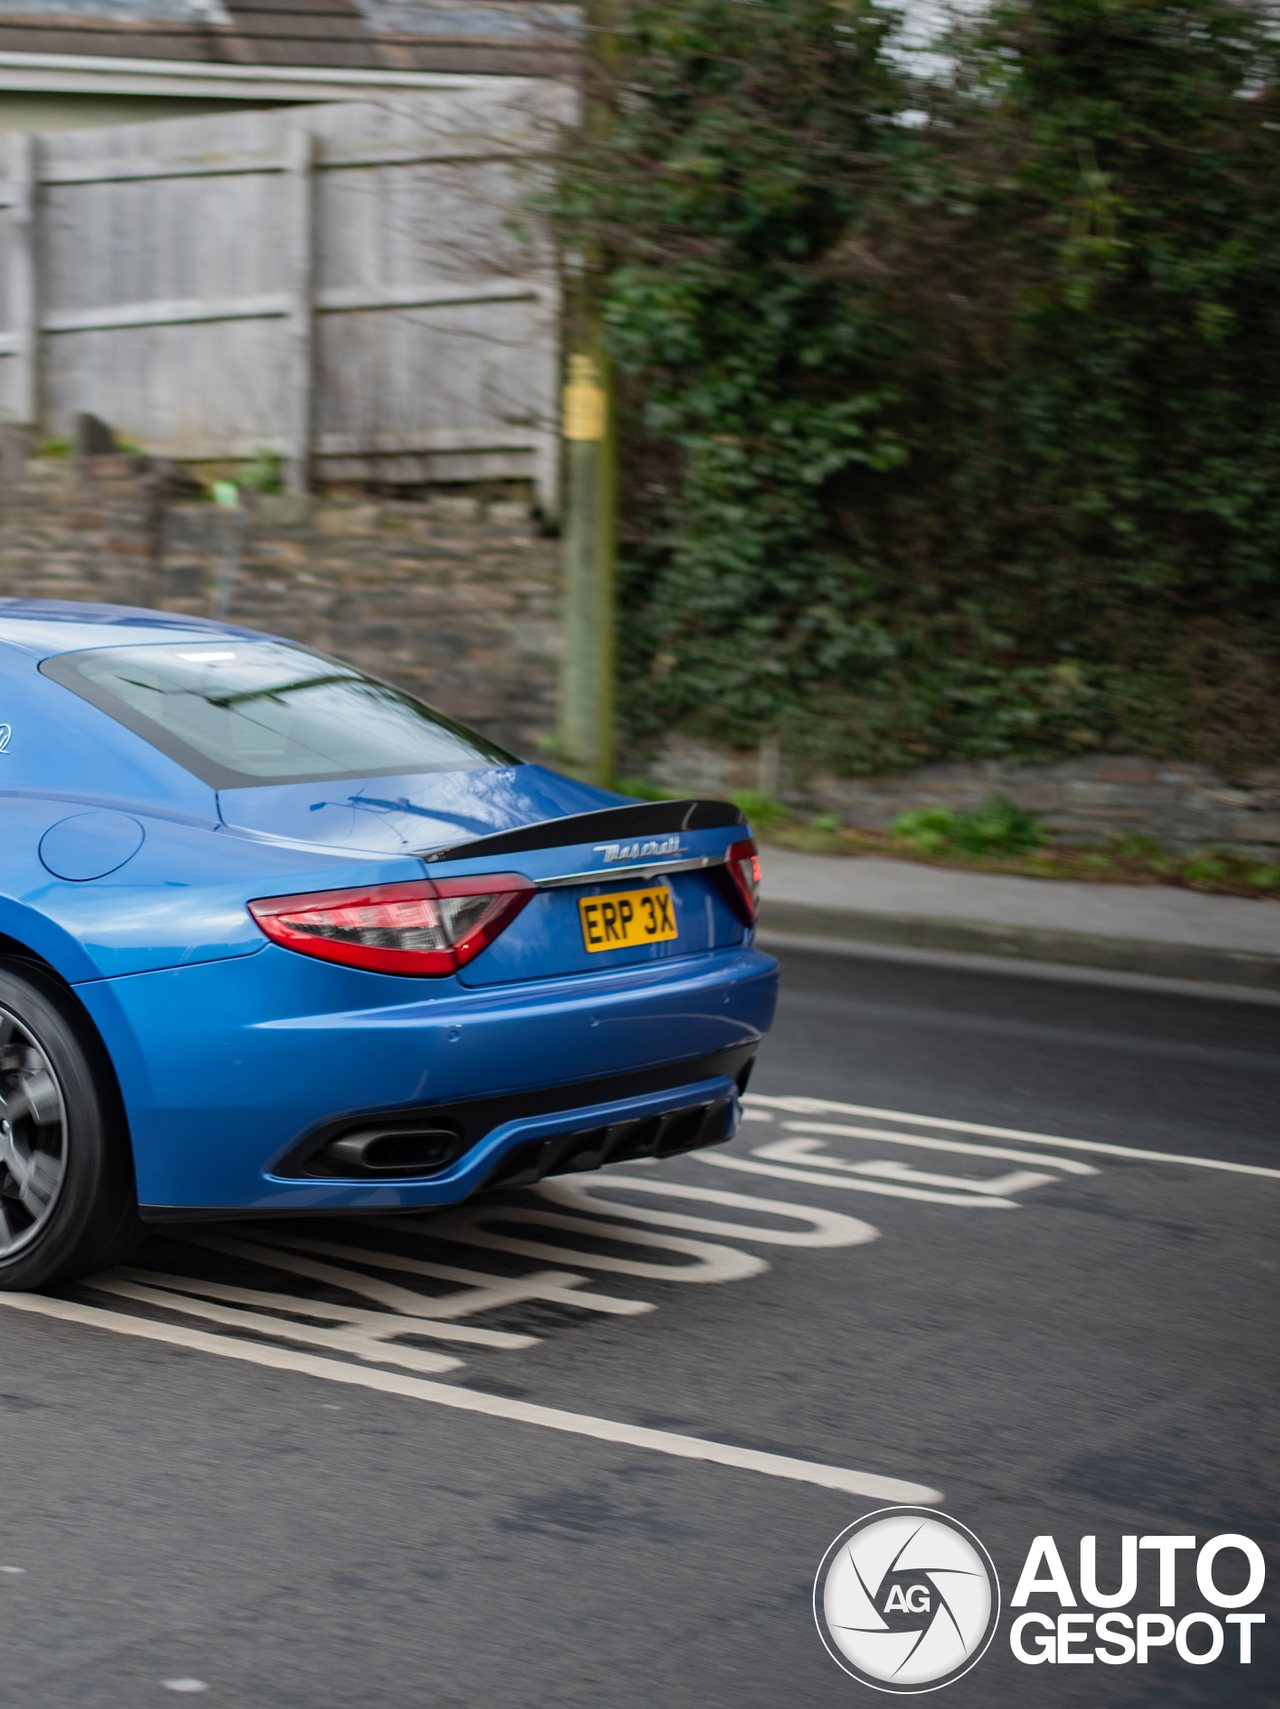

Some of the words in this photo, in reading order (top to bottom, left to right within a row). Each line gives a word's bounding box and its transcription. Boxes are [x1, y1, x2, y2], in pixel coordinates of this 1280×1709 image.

[593, 837, 688, 862] Maserati
[584, 900, 633, 944] ERP
[641, 894, 674, 935] 3X
